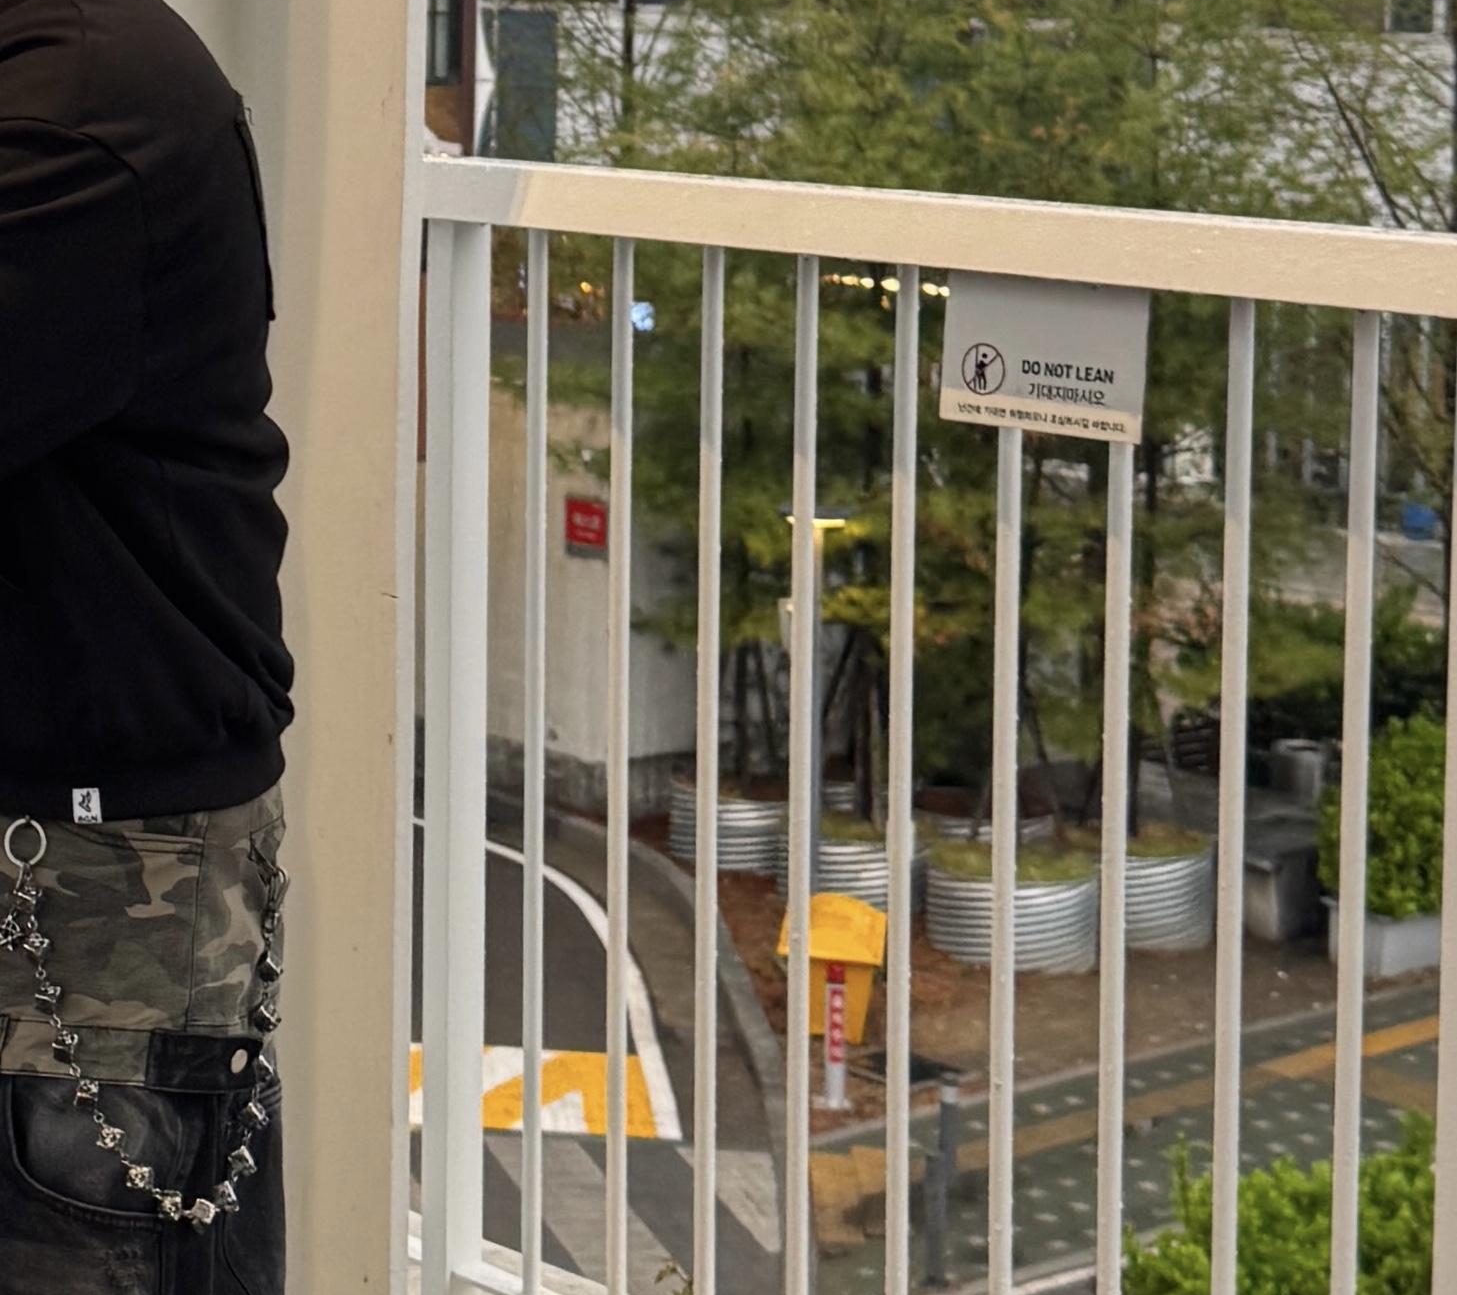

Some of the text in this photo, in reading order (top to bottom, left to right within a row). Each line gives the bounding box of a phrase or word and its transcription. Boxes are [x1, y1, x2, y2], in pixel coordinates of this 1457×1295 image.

[1022, 360, 1114, 385] DO NOT LEAN
